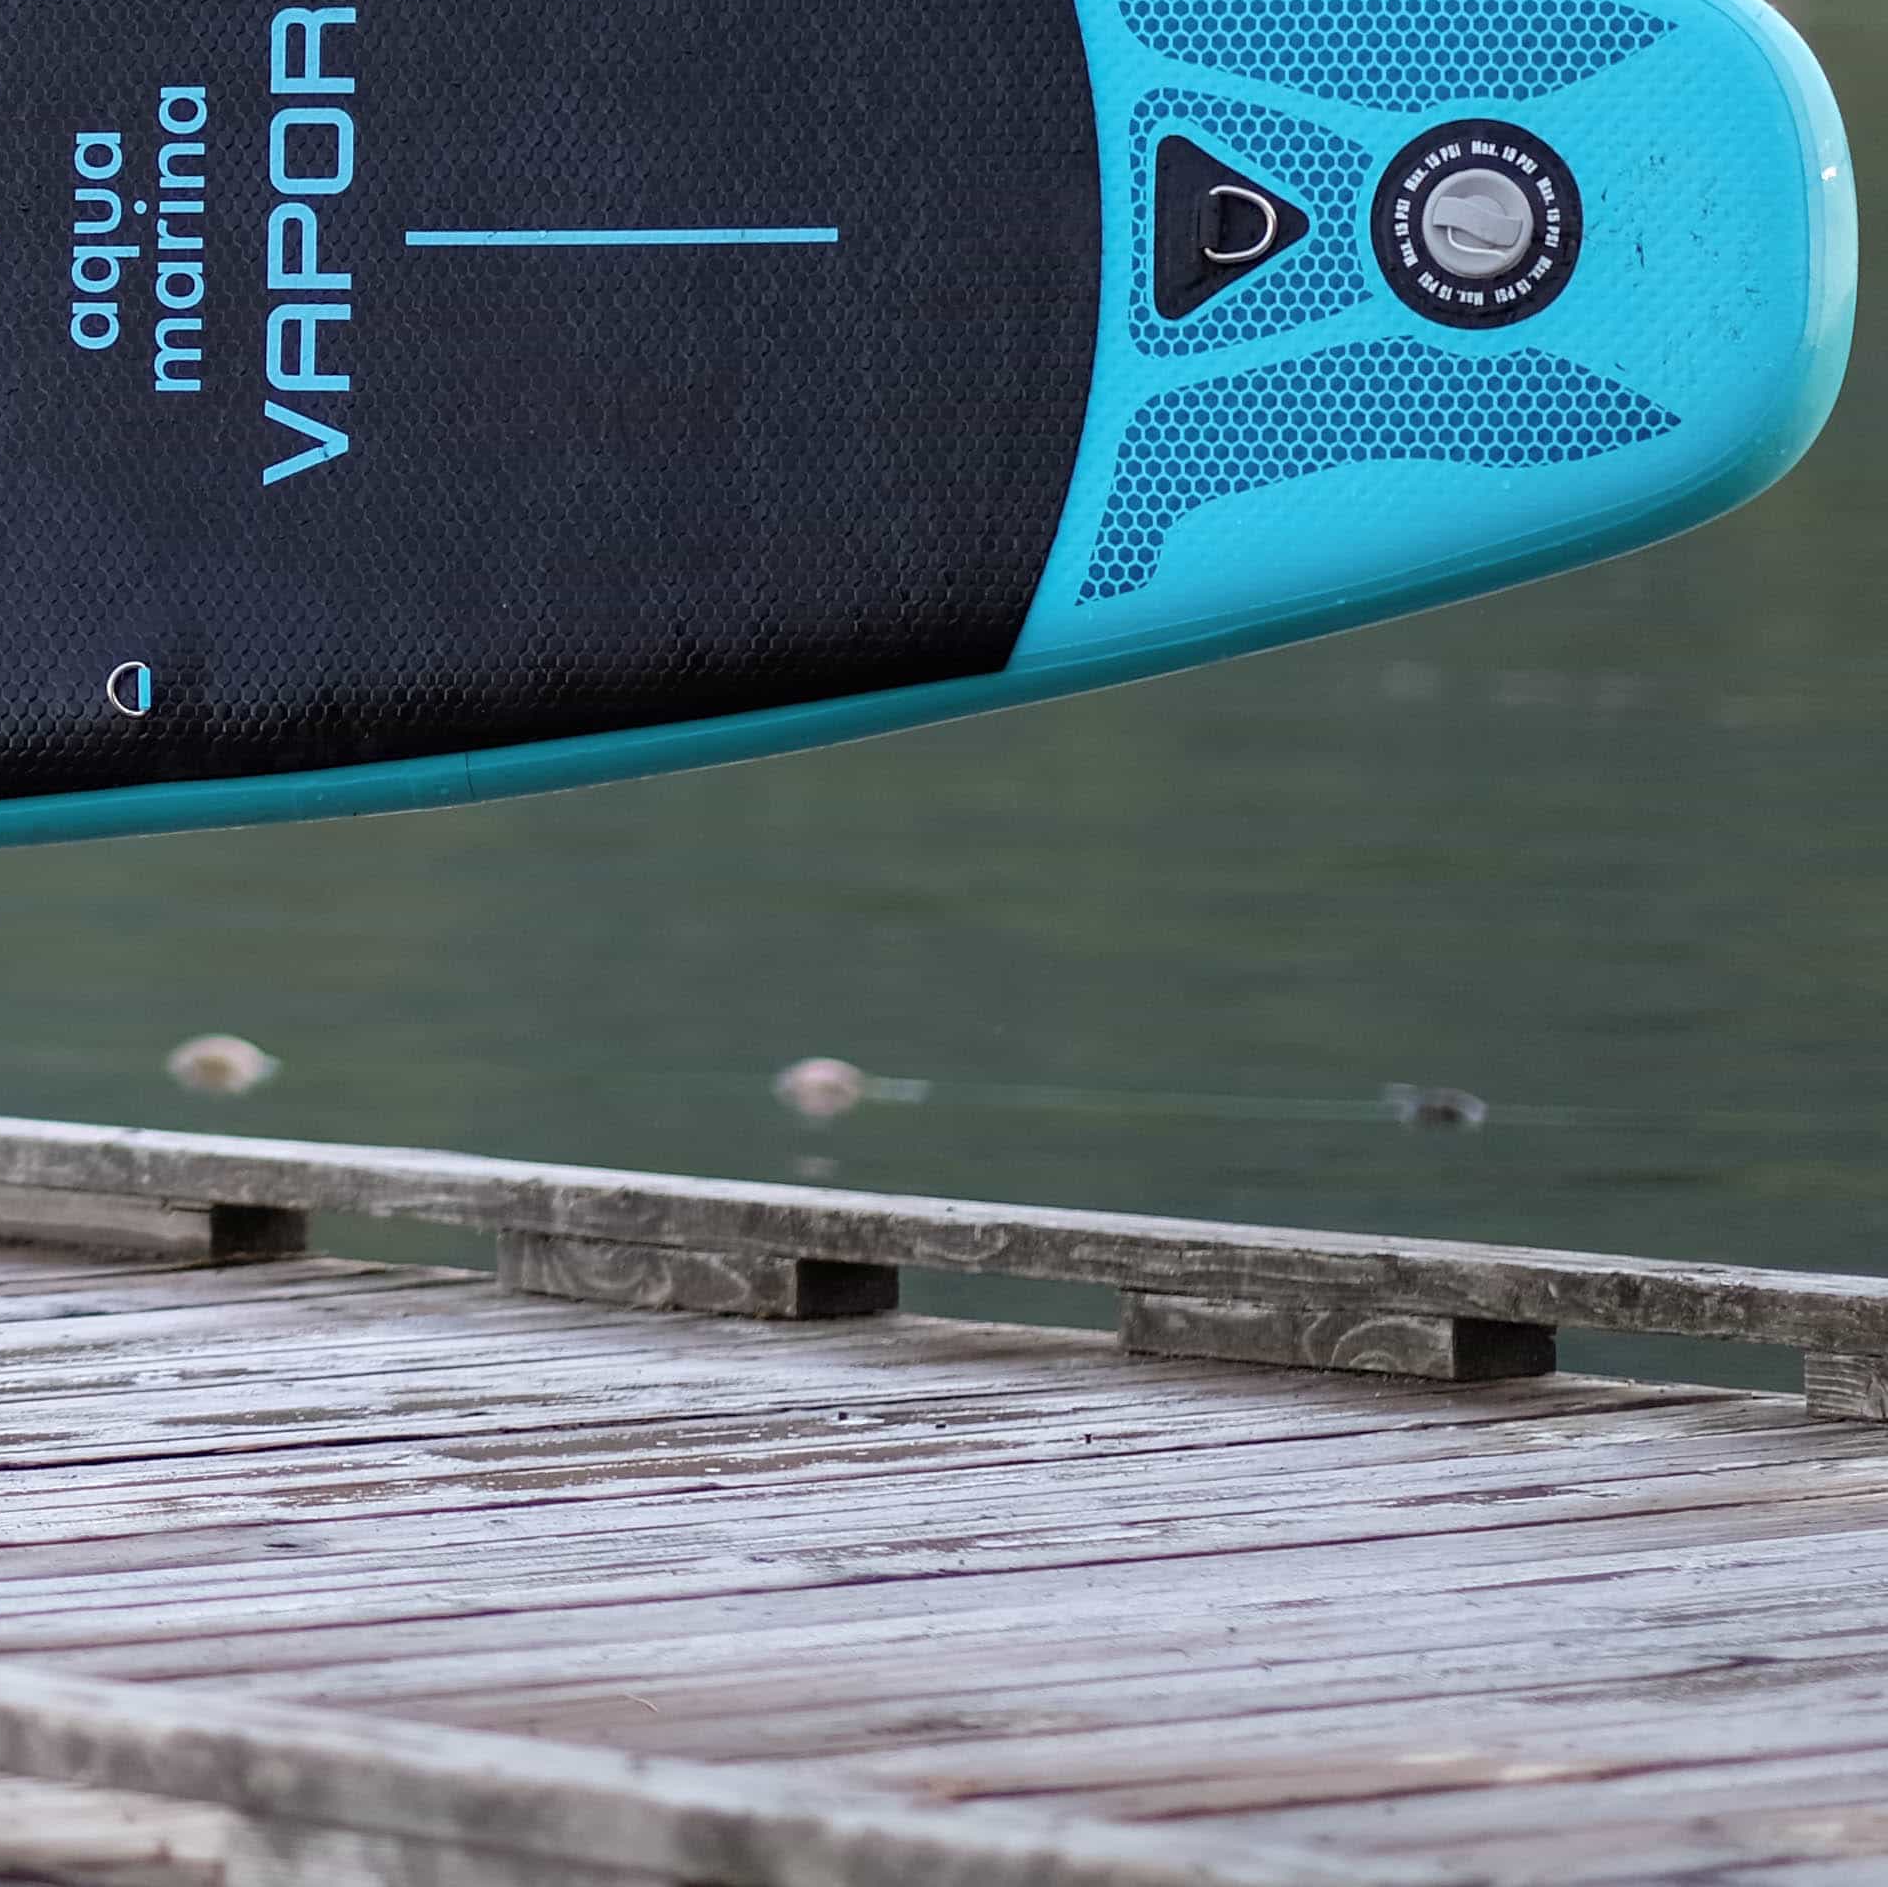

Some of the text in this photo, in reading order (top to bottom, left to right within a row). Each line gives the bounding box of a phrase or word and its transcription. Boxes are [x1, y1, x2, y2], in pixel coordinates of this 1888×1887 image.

[71, 133, 139, 349] aqua
[134, 87, 207, 391] marina
[263, 7, 356, 485] VAPOR
[1502, 145, 1517, 162] 15
[1515, 153, 1539, 175] PSI
[1417, 271, 1440, 294] PSI
